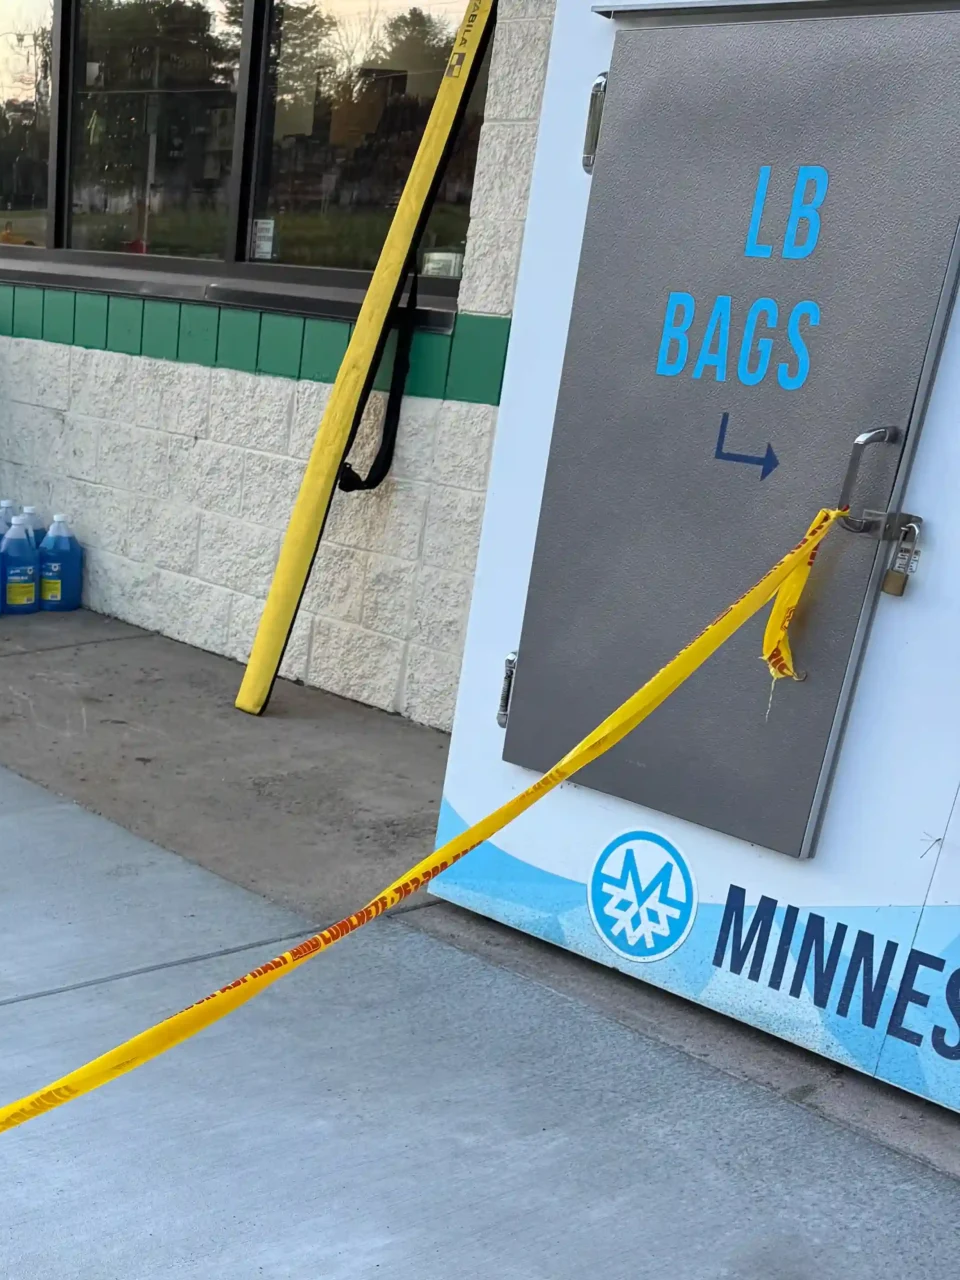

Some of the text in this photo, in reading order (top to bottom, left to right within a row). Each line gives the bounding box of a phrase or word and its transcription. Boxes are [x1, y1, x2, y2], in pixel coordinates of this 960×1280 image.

[459, 0, 482, 47] ABILA
[744, 165, 829, 259] LB
[656, 291, 821, 390] BAGS
